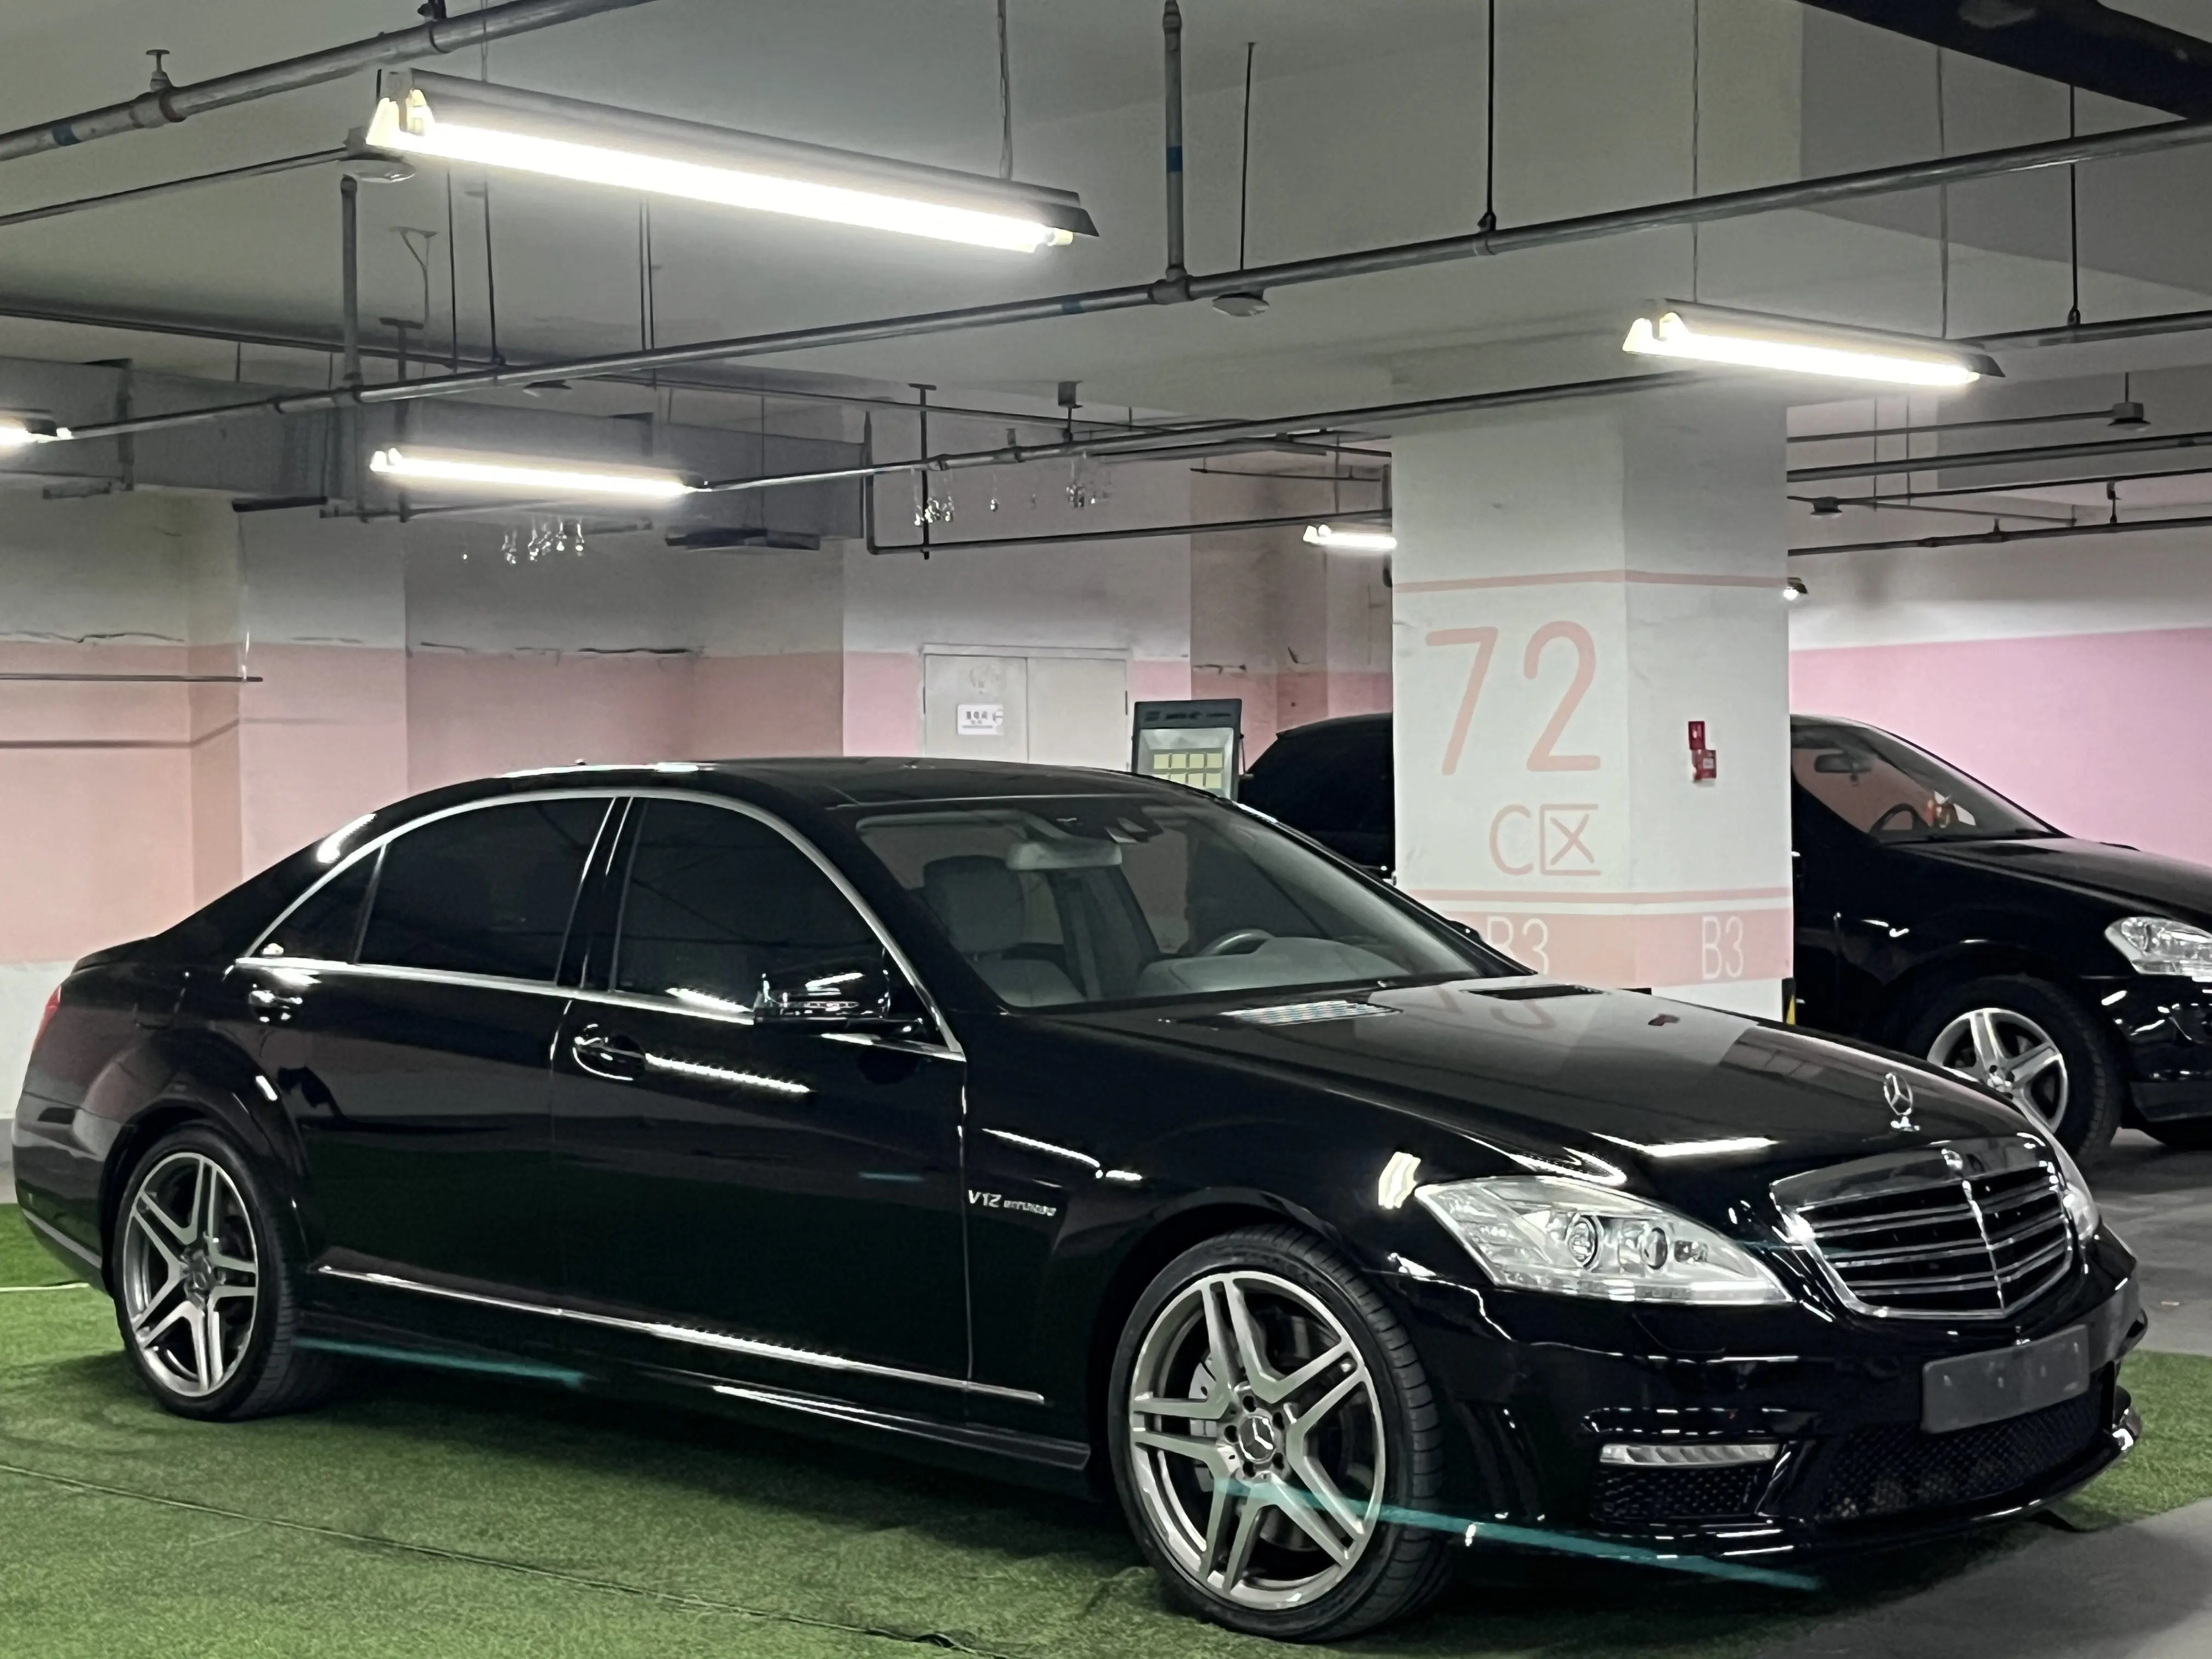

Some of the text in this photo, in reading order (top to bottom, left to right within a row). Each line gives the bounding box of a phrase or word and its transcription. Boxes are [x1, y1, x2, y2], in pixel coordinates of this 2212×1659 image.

[1426, 621, 1601, 776] 72
[1702, 916, 1744, 979] B3
[968, 1189, 1002, 1208] V12
